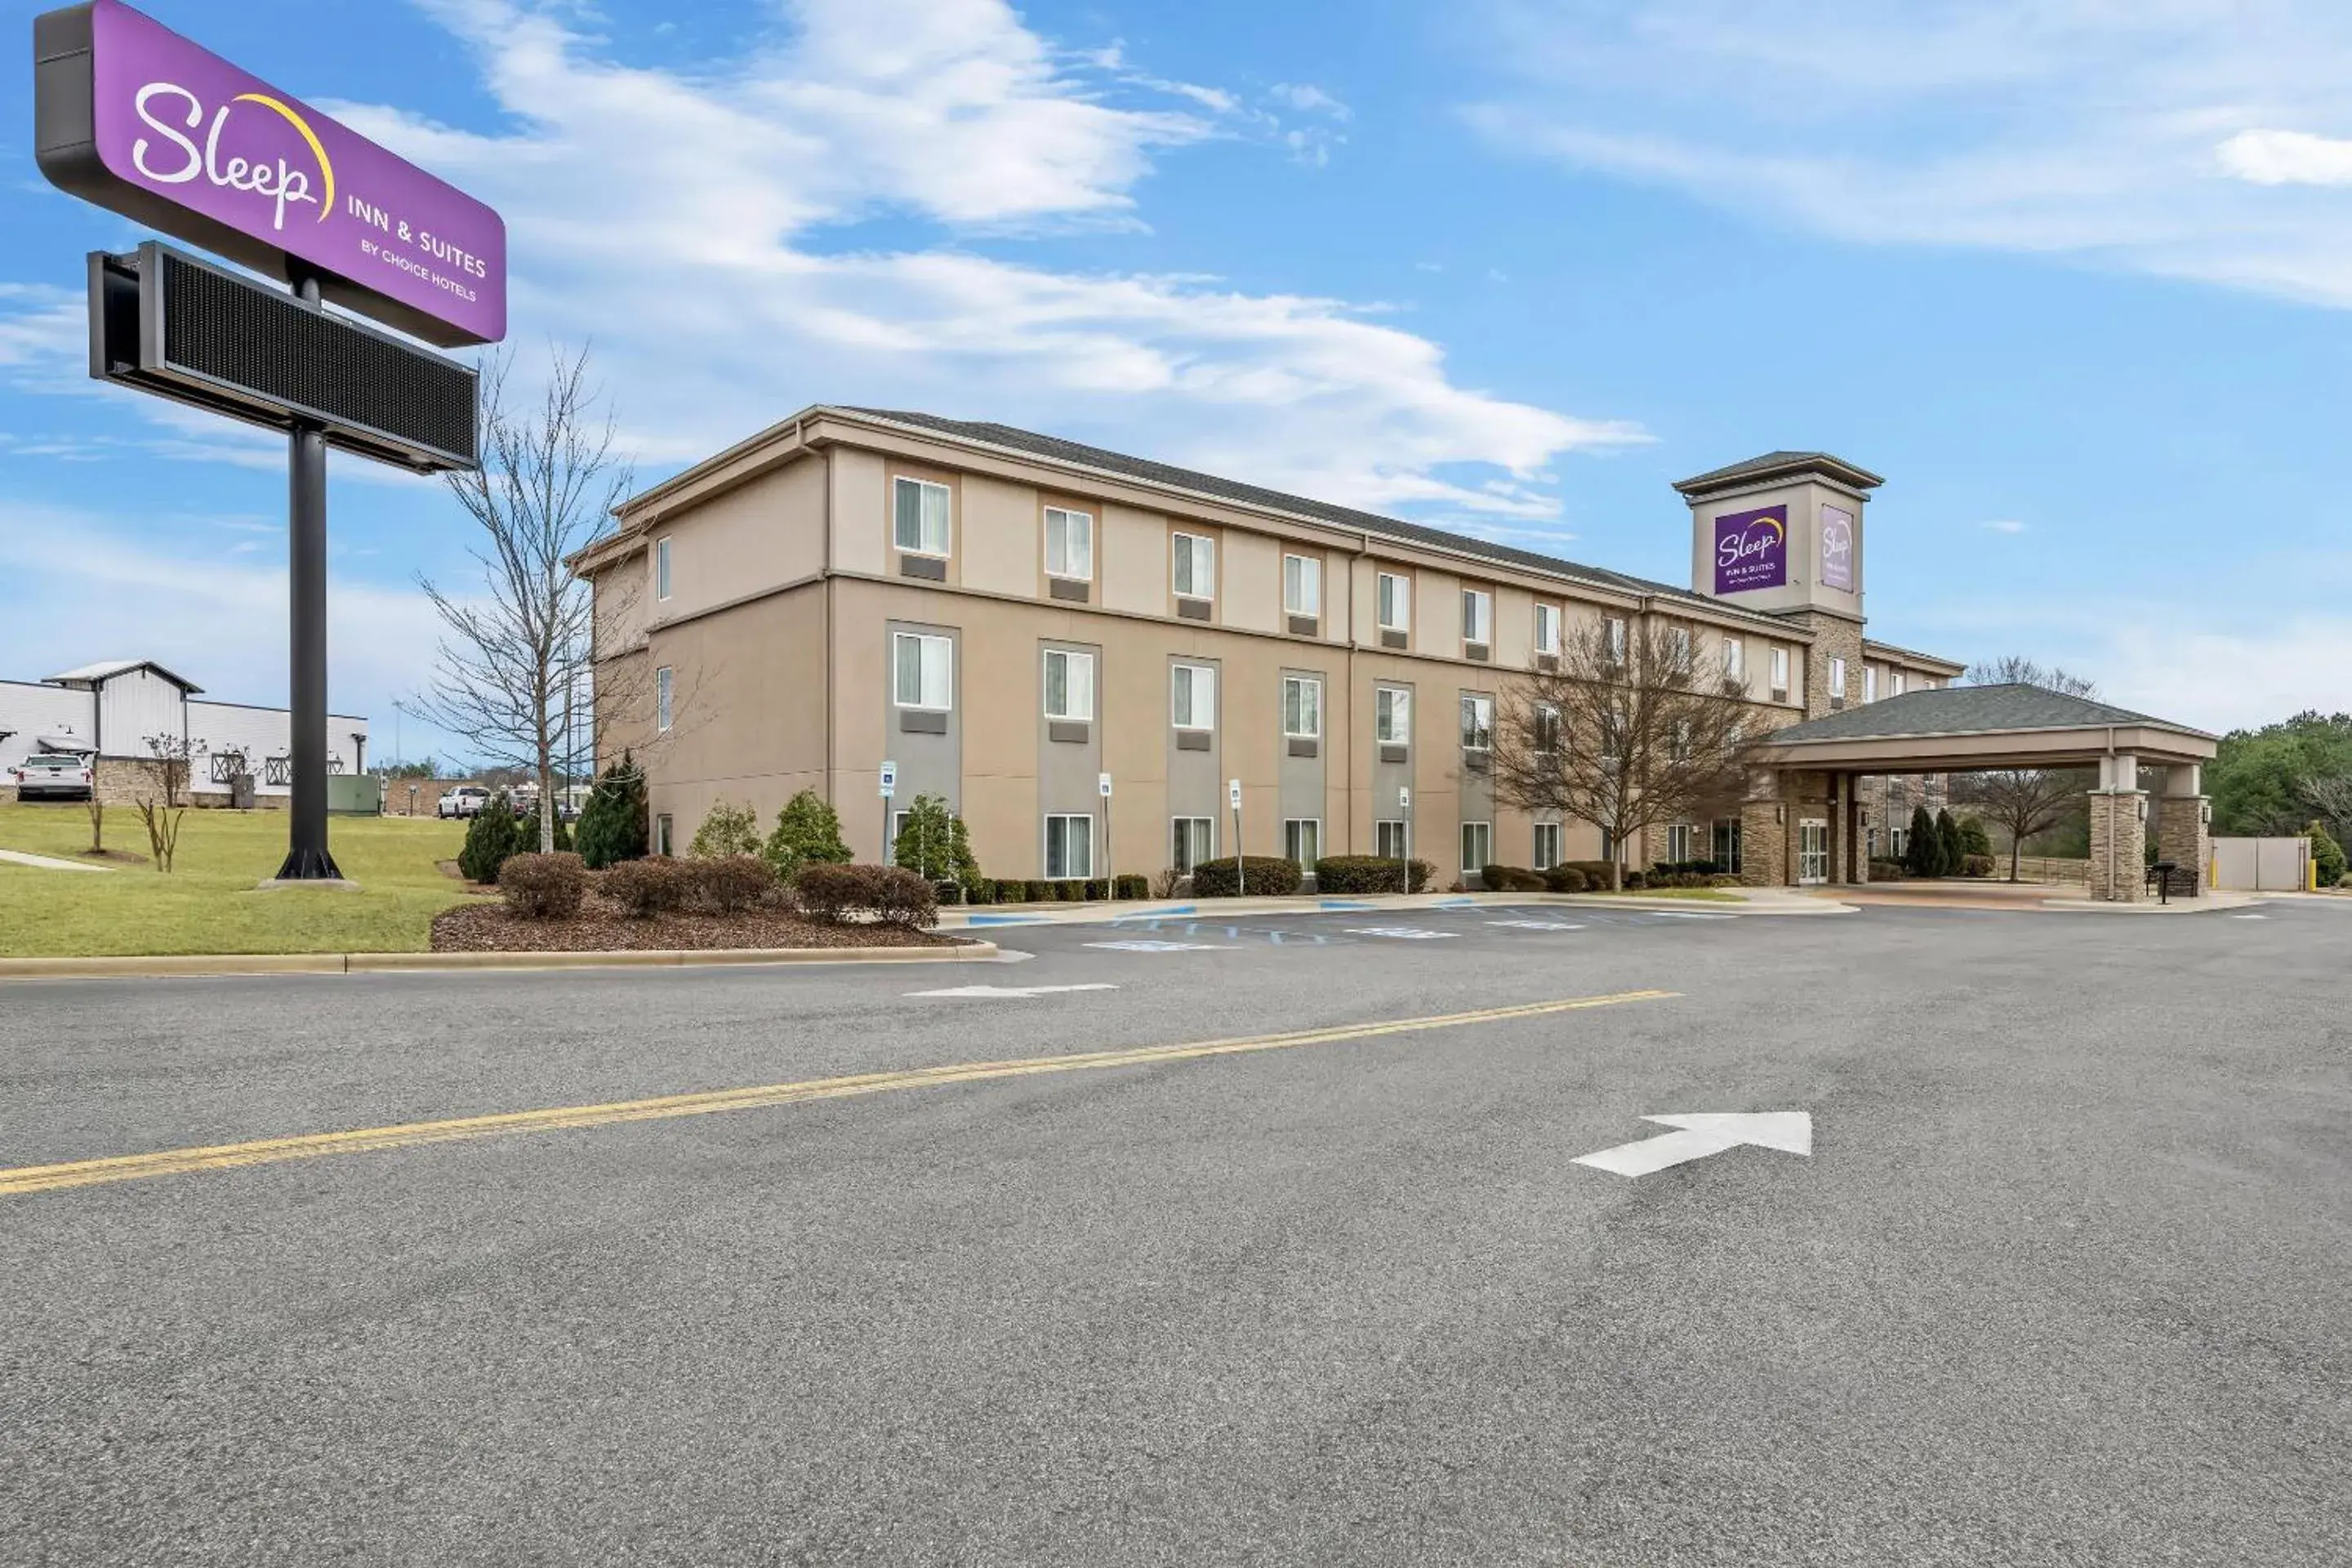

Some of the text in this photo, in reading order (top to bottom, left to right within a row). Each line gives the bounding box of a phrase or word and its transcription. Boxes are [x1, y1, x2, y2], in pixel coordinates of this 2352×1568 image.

[132, 82, 318, 230] Sleep
[348, 194, 487, 278] INN & SUITES
[361, 238, 477, 303] BY CHOICE HOTELS
[1717, 530, 1776, 567] Sleep
